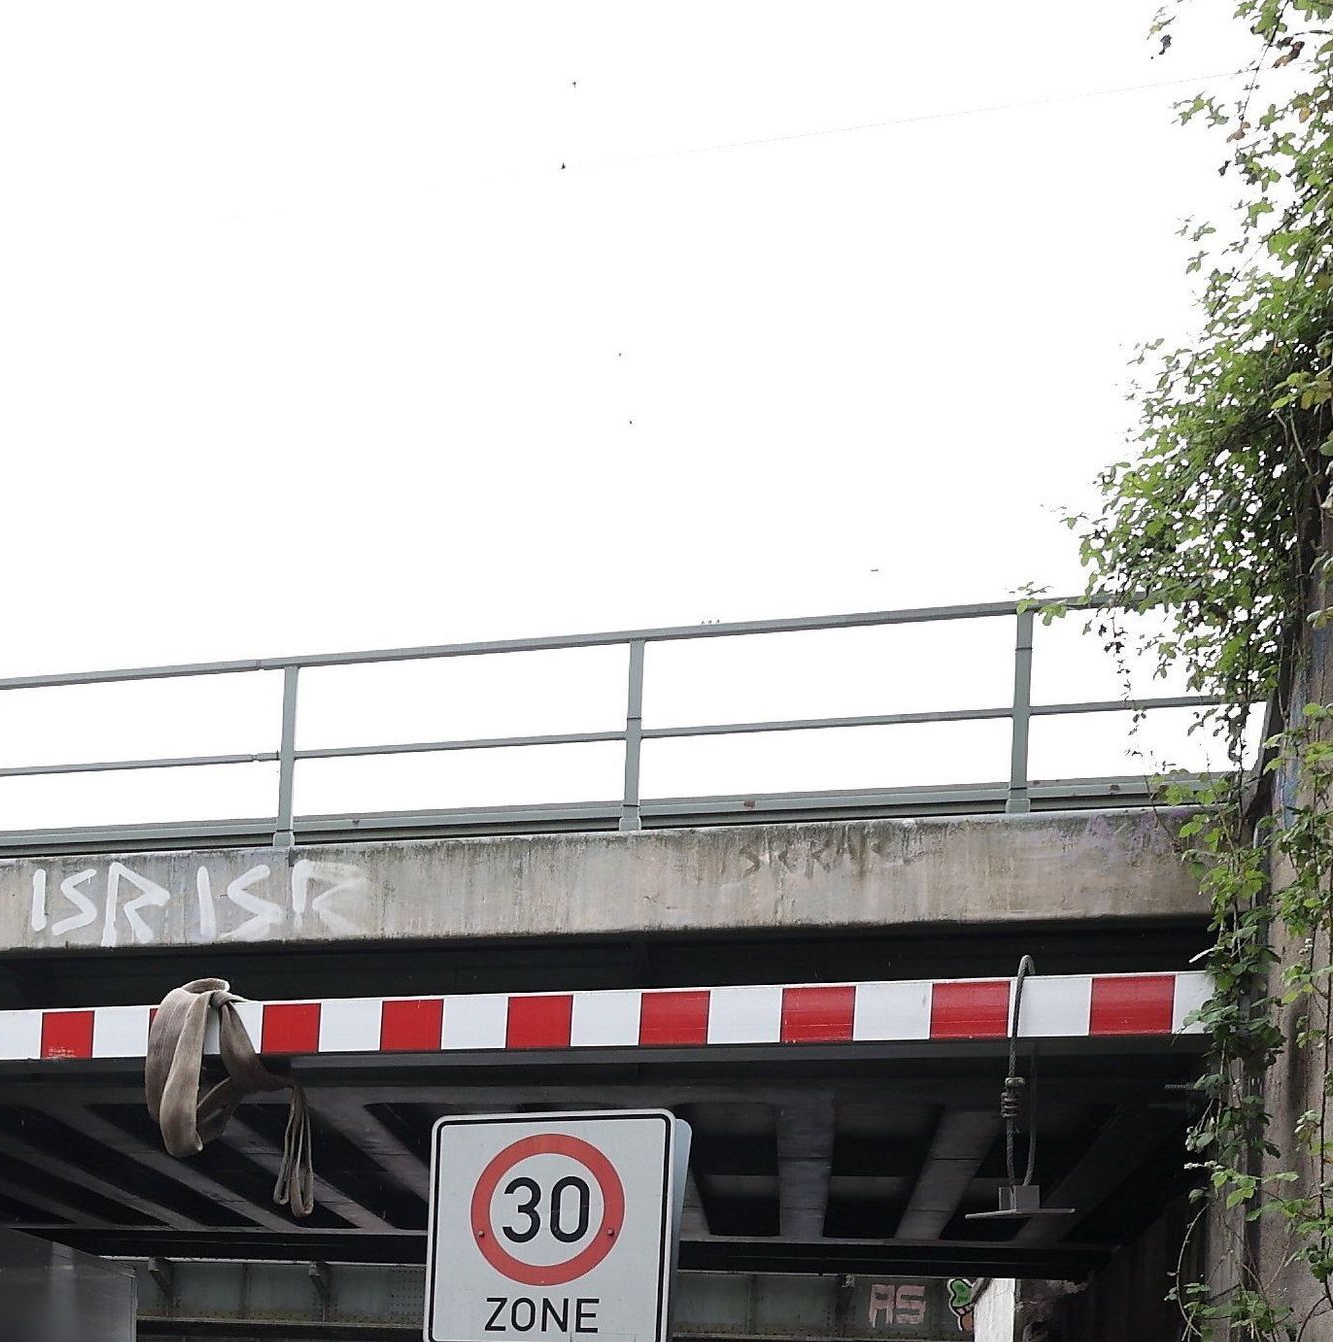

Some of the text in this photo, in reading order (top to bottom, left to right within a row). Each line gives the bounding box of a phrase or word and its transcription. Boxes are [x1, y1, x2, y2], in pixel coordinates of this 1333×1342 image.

[32, 861, 170, 947] ISR
[502, 1175, 590, 1243] 30
[484, 1297, 600, 1333] ZONE
